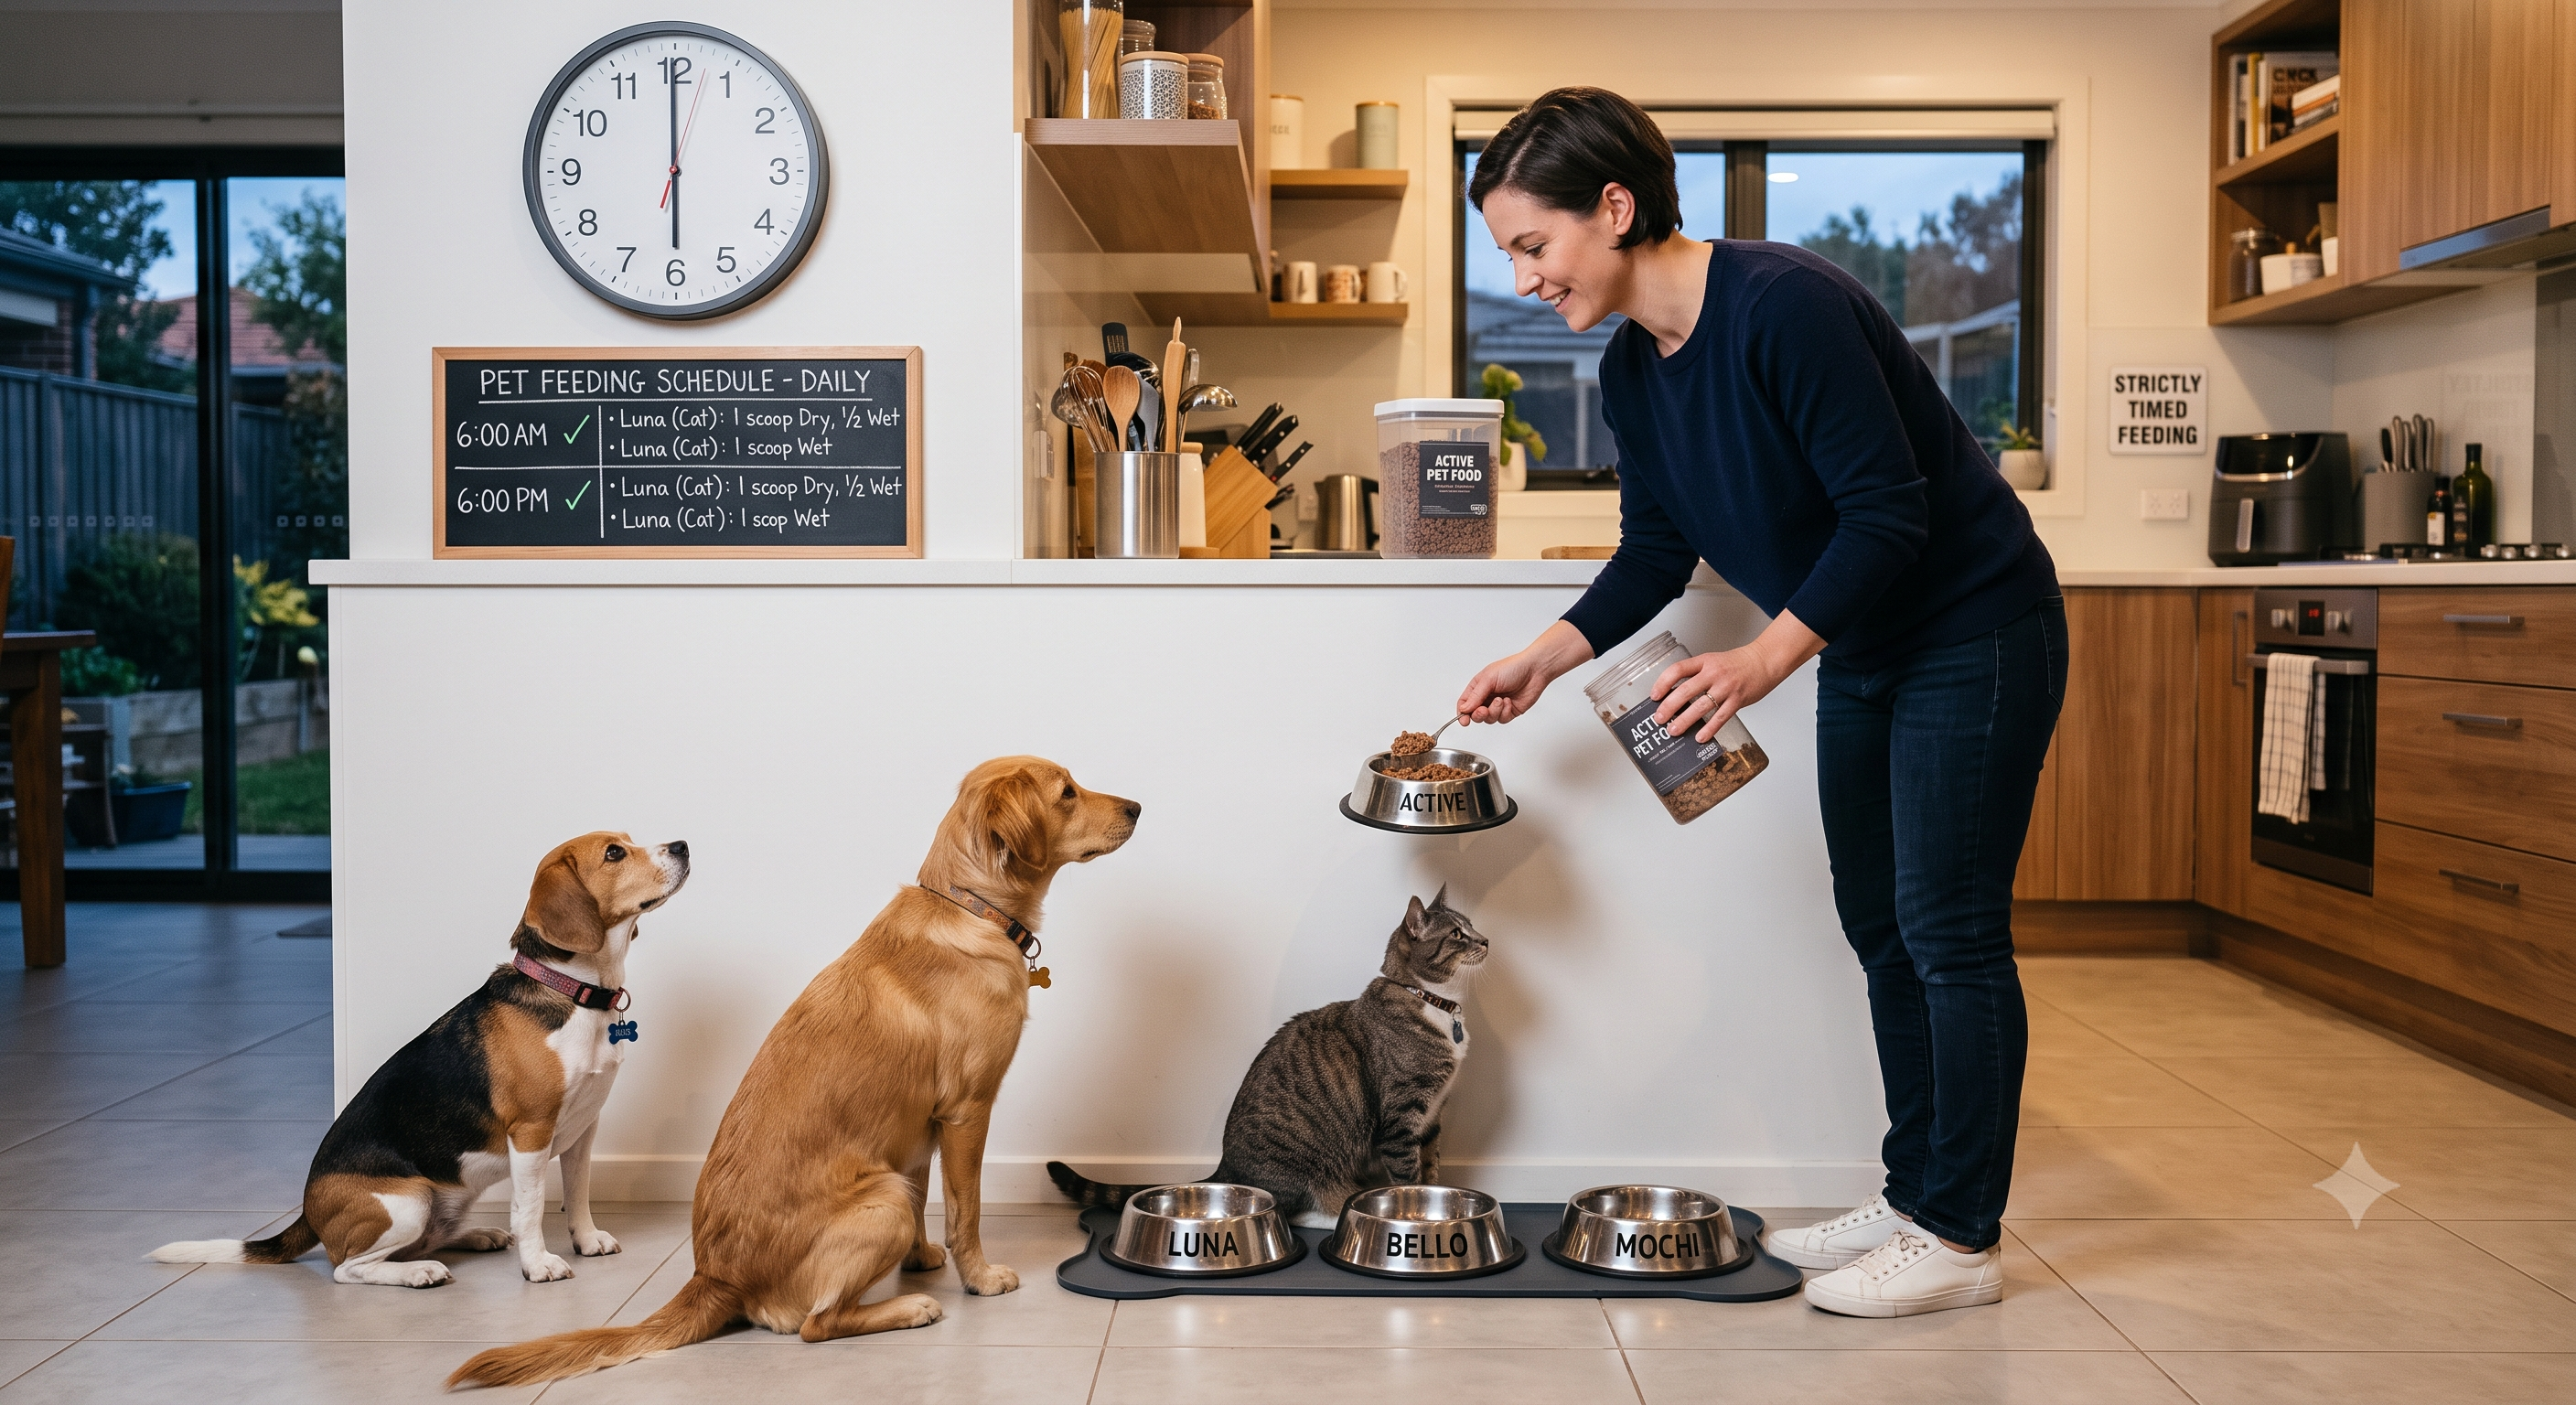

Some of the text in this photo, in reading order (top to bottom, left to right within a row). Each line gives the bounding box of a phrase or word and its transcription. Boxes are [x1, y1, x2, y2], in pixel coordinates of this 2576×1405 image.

[657, 56, 692, 86] 12
[719, 70, 731, 99] 1
[610, 71, 637, 100] 11
[573, 109, 607, 138] 10
[755, 107, 776, 134] 2
[561, 157, 582, 187] 9
[768, 157, 790, 186] 3
[577, 209, 598, 237] 8
[753, 208, 775, 236] 4
[616, 246, 638, 273] 7
[665, 258, 686, 287] 6
[715, 246, 736, 273] 5
[480, 369, 530, 395] PET
[542, 369, 646, 394] FEEDING
[657, 369, 775, 393] SCHEDULE
[801, 369, 871, 393] DAILY
[2116, 375, 2201, 392] STRICTLY
[620, 408, 667, 428] Luna
[671, 405, 725, 432] (Cat):
[746, 413, 793, 433] scoop
[799, 407, 835, 435] Dry,
[866, 406, 901, 427] Wet
[2129, 401, 2186, 418] TIMED
[456, 421, 548, 448] 6:00 AM
[621, 438, 668, 457] Luna
[672, 435, 726, 461] (Cat):
[747, 443, 793, 461] scoop
[797, 436, 833, 456] Wet
[2119, 426, 2196, 444] FEEDING
[1434, 455, 1475, 467] ACTIVE
[1426, 468, 1482, 482] PET FOOD
[457, 487, 549, 514] 6:00 PM
[621, 476, 670, 498] Luna
[676, 474, 730, 501] (Cat):
[751, 482, 798, 501] scoop
[803, 476, 839, 505] Dry,
[869, 476, 903, 496] Wet
[622, 508, 671, 529] Luna
[677, 505, 734, 533] (Cat):
[753, 515, 789, 534] scop
[793, 508, 831, 528] Wet
[1633, 738, 1654, 759] PET
[1400, 792, 1466, 812] ACTIVE
[1168, 1231, 1240, 1258] LUNA
[1386, 1232, 1468, 1259] BELLO
[1615, 1232, 1700, 1260] MOCHI
